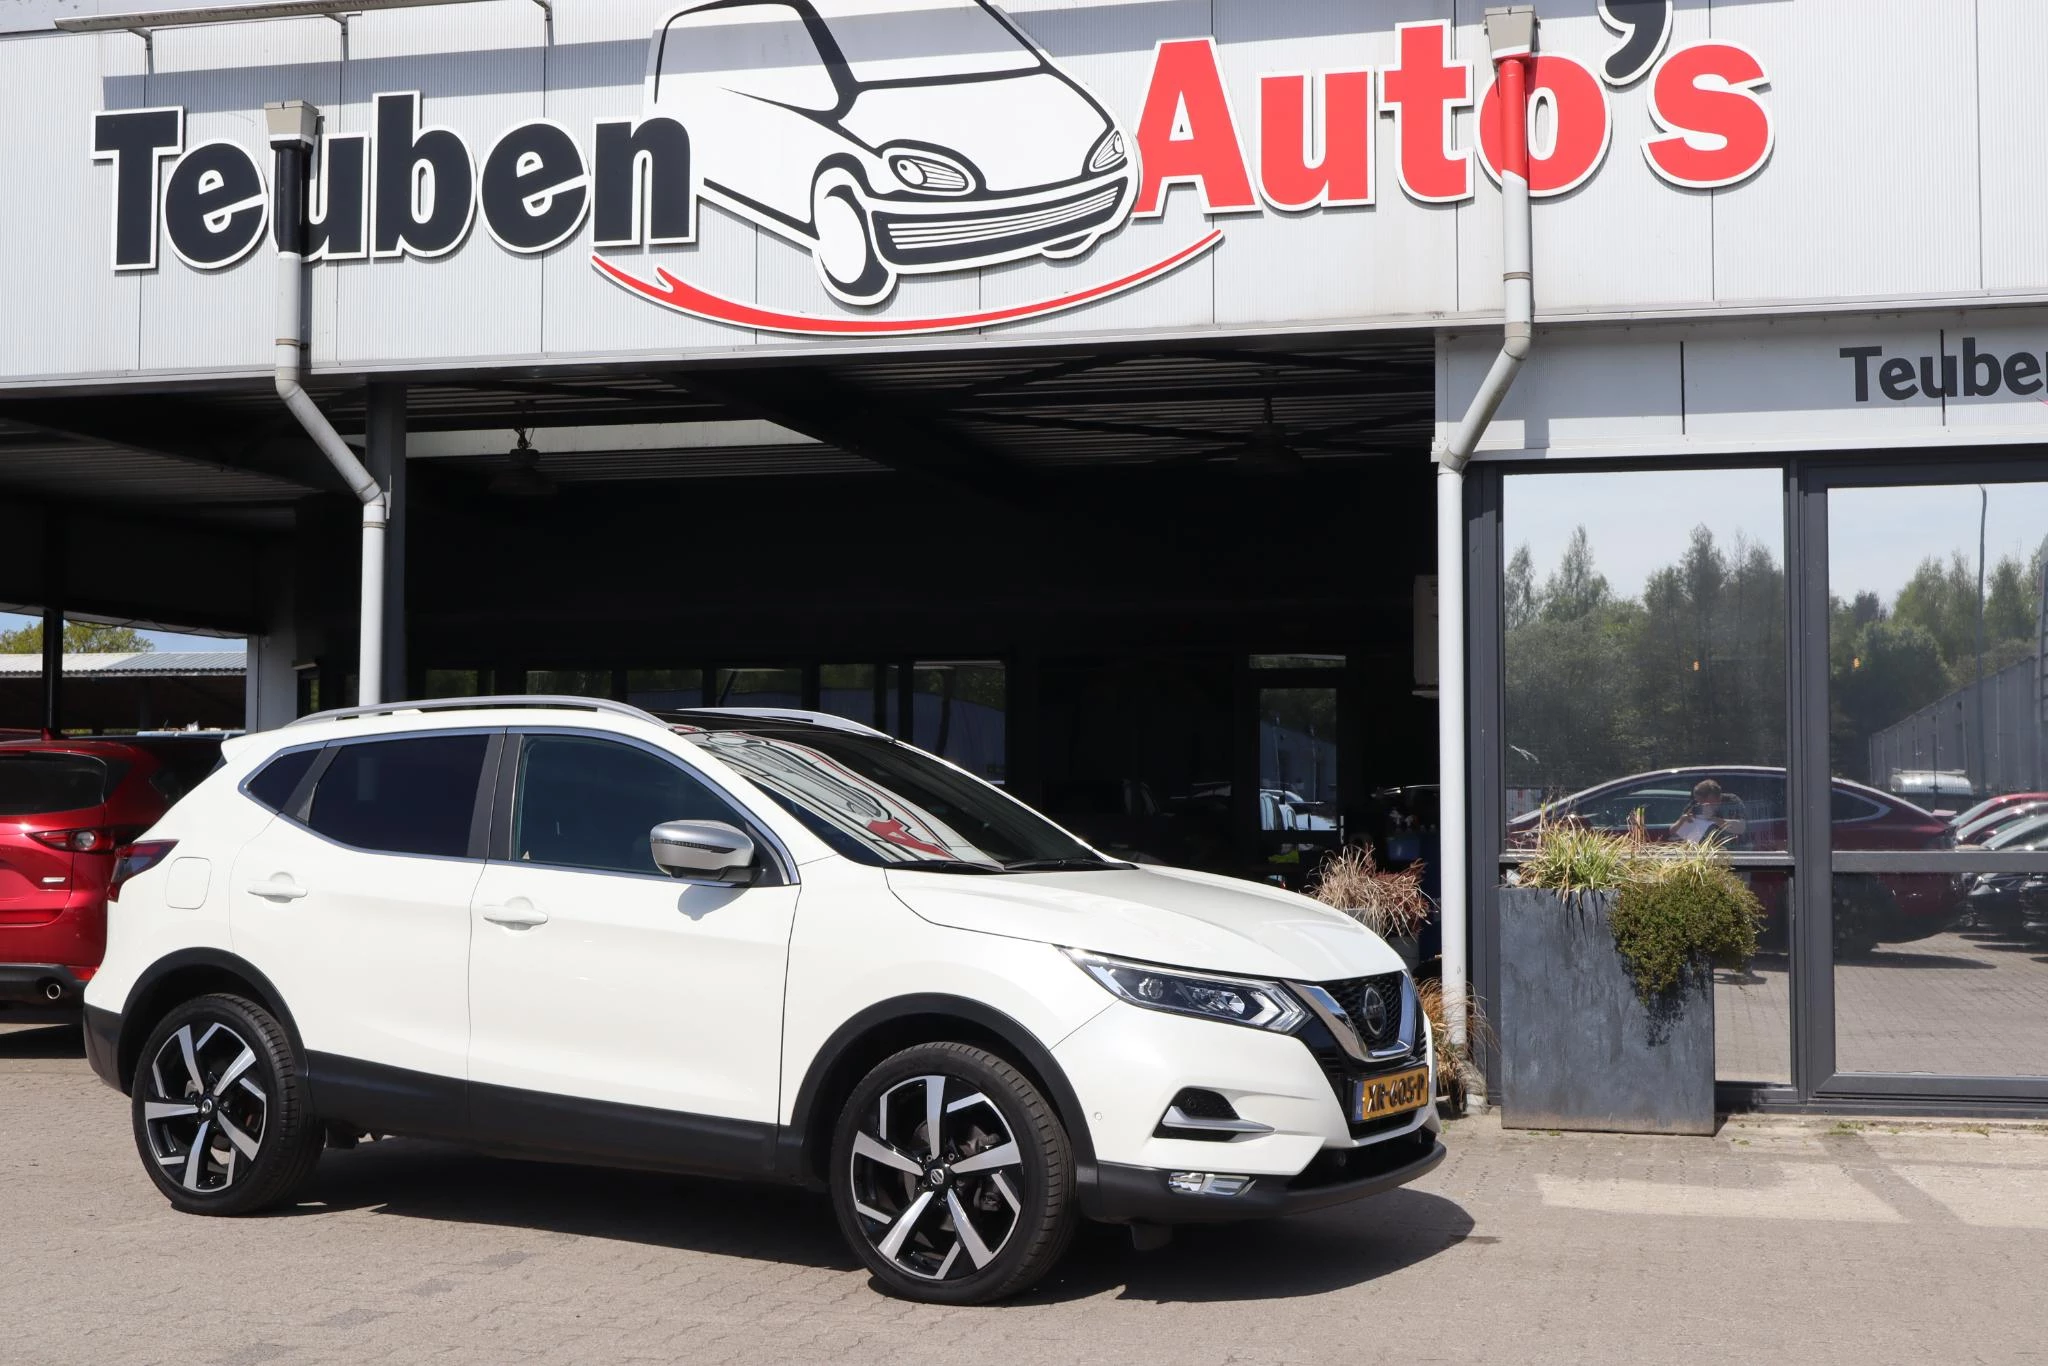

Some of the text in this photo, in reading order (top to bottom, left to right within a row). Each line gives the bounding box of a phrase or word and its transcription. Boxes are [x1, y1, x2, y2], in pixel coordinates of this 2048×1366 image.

[92, 0, 1775, 271] Teuben Auto's
[1839, 337, 2048, 402] Teube
